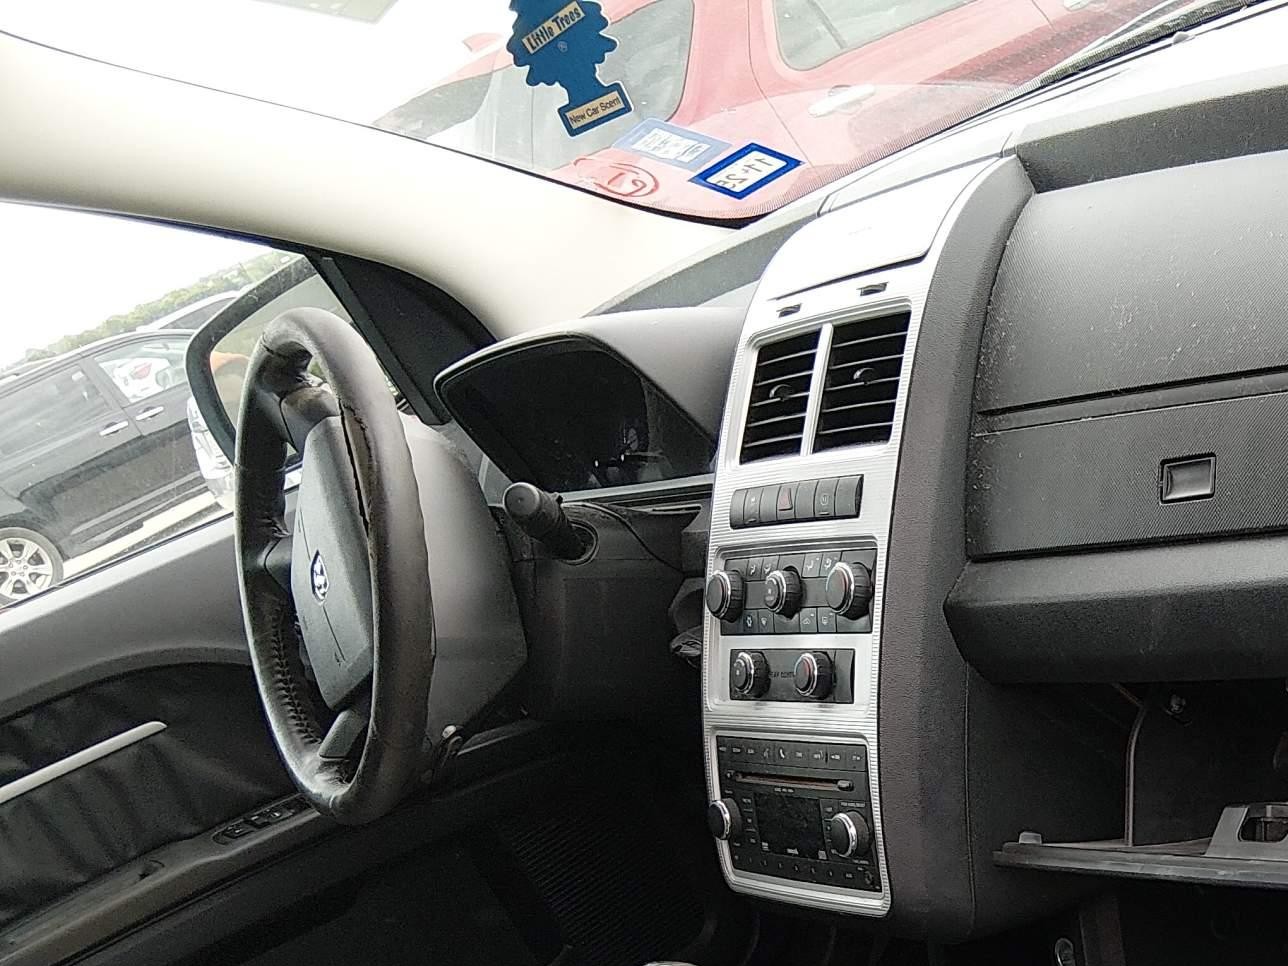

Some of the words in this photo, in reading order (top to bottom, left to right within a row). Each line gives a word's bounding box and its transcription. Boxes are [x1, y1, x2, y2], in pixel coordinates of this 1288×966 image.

[526, 26, 555, 51] Little
[552, 7, 582, 31] Trees
[569, 112, 586, 124] New
[586, 105, 600, 118] Car
[600, 97, 622, 109] Scent
